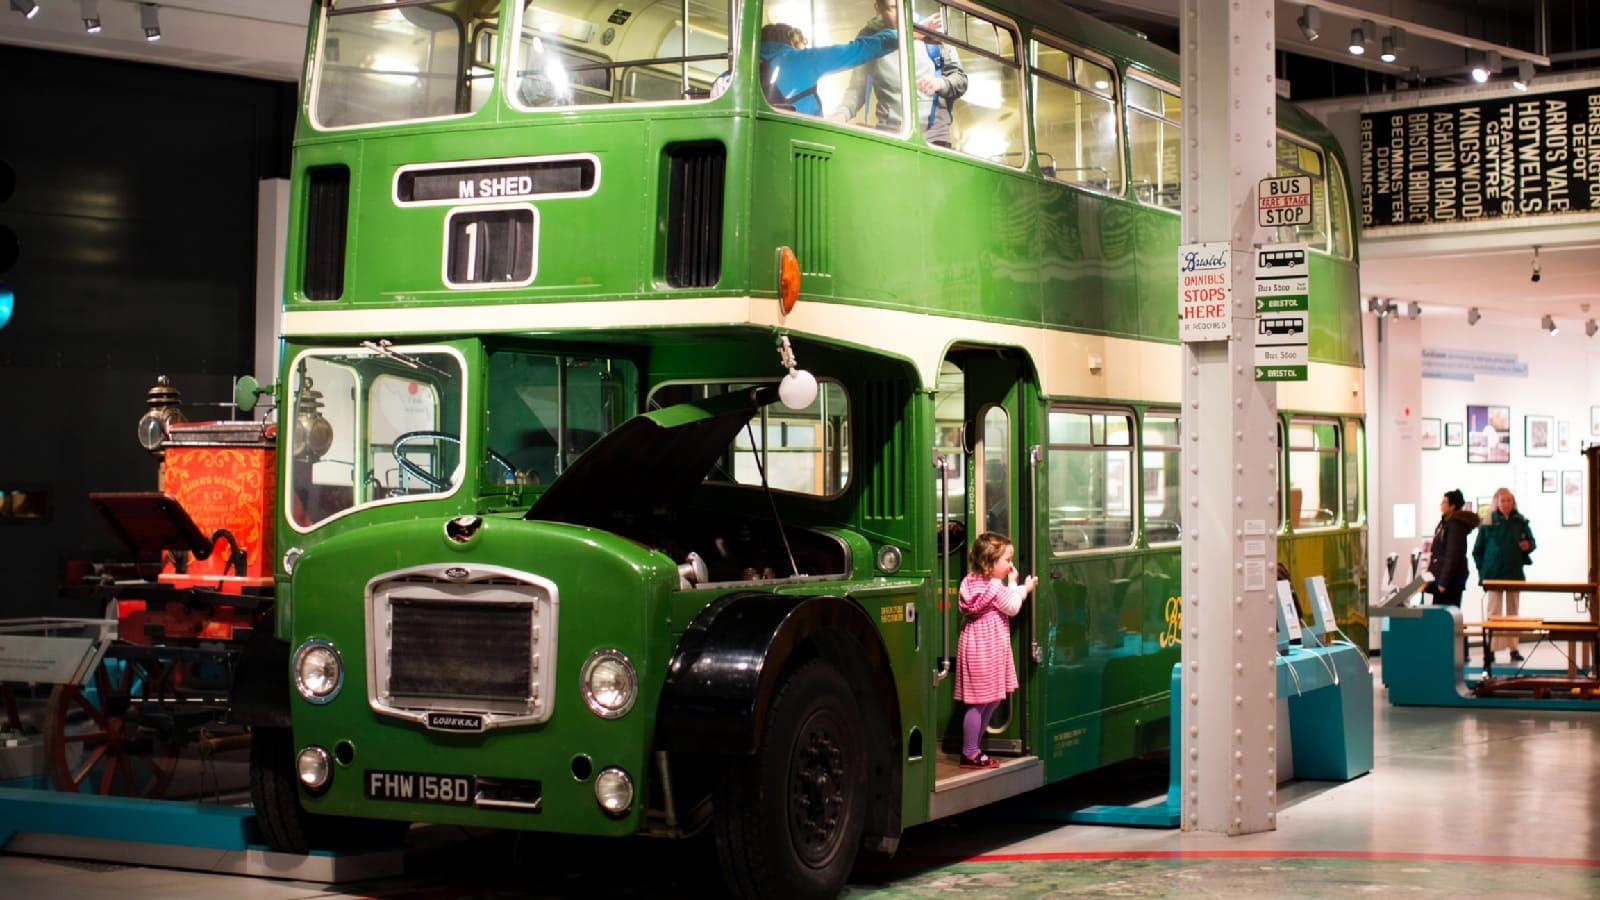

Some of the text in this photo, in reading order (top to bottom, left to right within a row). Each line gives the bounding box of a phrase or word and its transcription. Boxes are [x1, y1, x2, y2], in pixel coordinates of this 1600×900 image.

[1361, 119, 1373, 225] BEDMINSTER
[1377, 147, 1390, 194] DOWN
[1391, 115, 1404, 222] BEDMINSTER
[1408, 112, 1430, 221] BRISTOL BRIDGE
[1433, 112, 1457, 220] ASHTON ROAD
[1459, 107, 1483, 217] KINGSWOOD
[1485, 121, 1500, 199] CENTRE
[1500, 103, 1514, 215] TRAMWAYS
[1518, 101, 1543, 213] HOTWELLS
[1545, 99, 1570, 211] ARNO'S VALE
[1573, 123, 1587, 181] DEPOT
[1588, 94, 1600, 208] BRISLINGTON
[459, 176, 532, 199] M SHED
[1266, 208, 1303, 224] STOP
[1270, 179, 1300, 195] BUS
[465, 222, 478, 281] 1
[1182, 249, 1228, 272] Bristol
[1184, 273, 1225, 287] OMNIBUS
[1184, 288, 1226, 303] STOPS
[1184, 304, 1225, 319] HERE
[1268, 299, 1299, 308] BRISTOL
[1267, 369, 1298, 378] BRISTOL
[371, 773, 469, 801] FHW 158D
